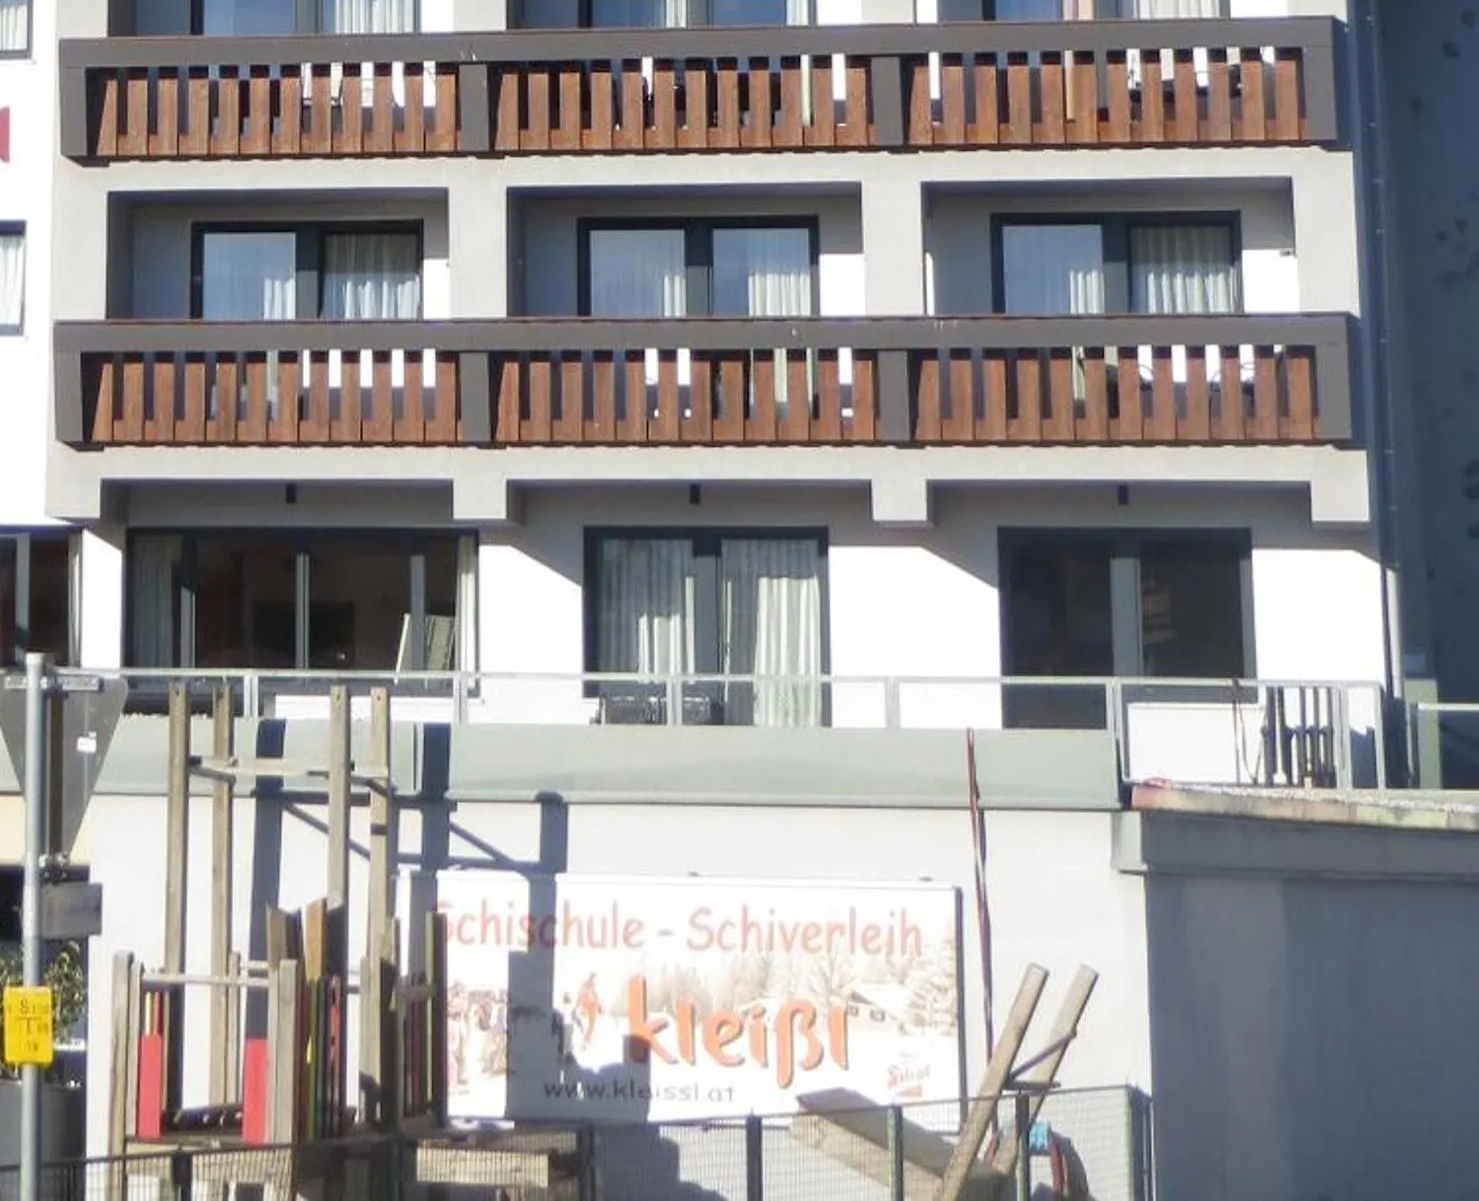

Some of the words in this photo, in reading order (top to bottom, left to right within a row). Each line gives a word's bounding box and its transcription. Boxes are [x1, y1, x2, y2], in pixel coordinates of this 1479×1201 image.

[686, 902, 923, 957] Schiverleih
[626, 974, 849, 1089] kleißl
[543, 1078, 734, 1101] www.kleissl.at
